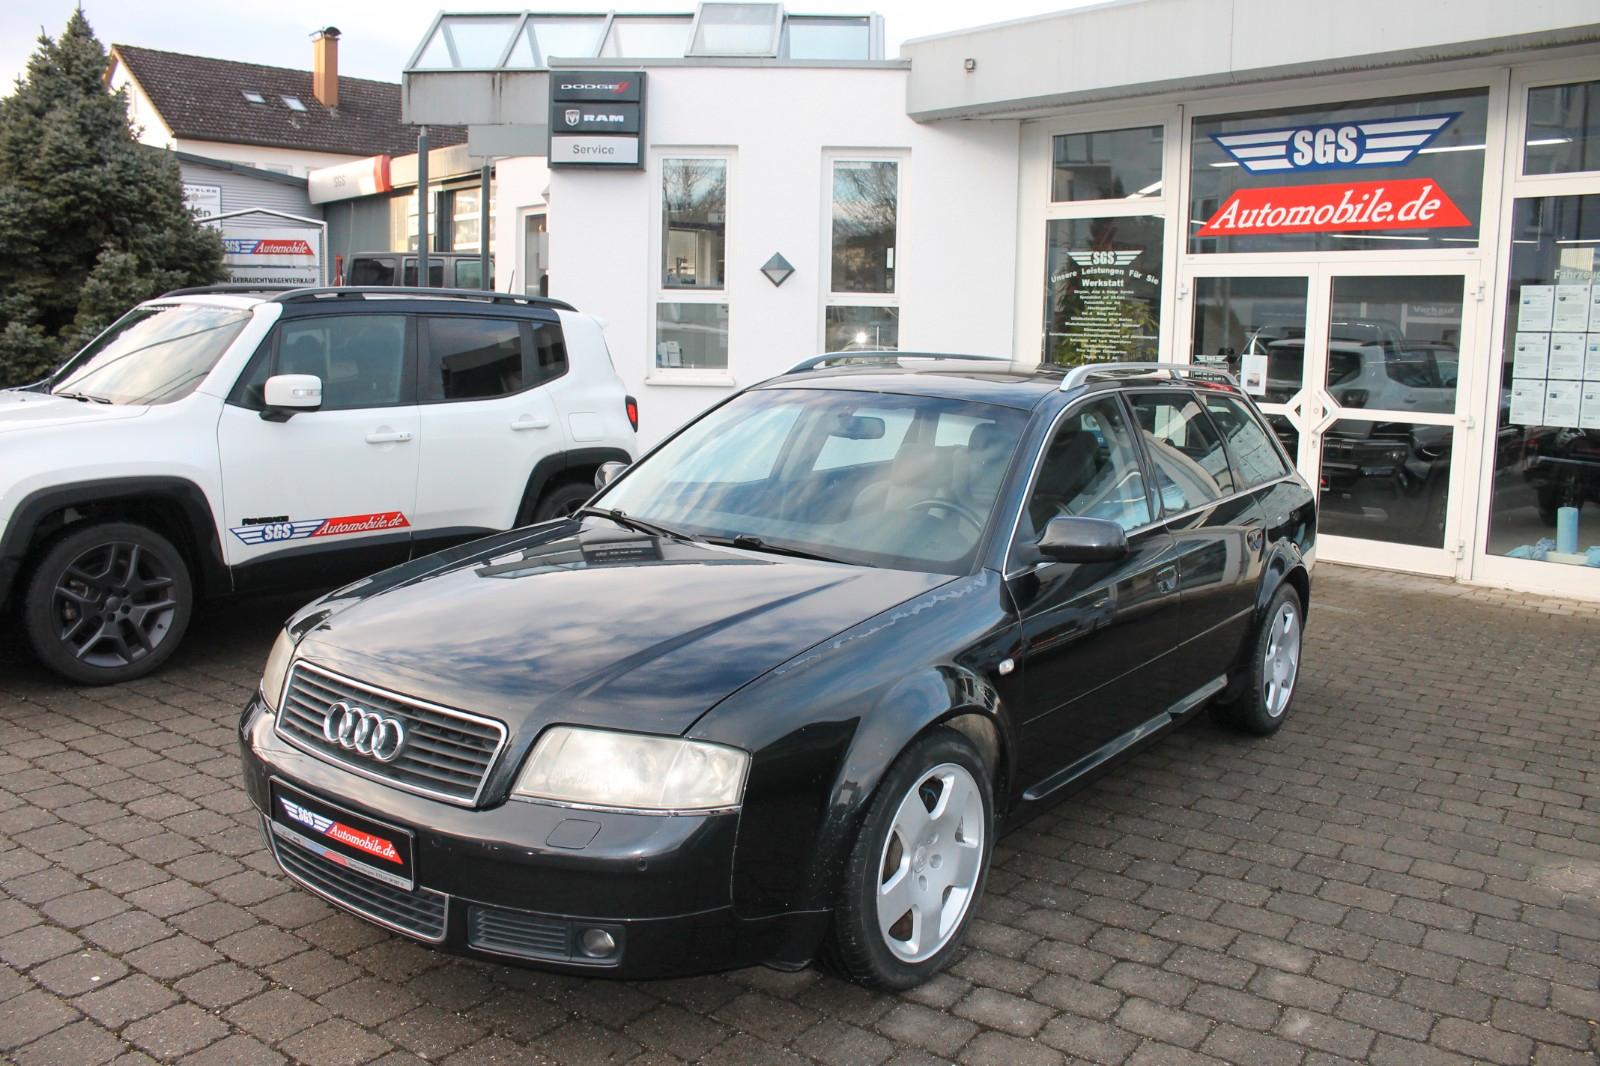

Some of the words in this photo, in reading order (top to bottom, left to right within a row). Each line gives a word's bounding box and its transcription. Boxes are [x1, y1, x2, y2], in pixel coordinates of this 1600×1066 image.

[583, 114, 624, 122] RAM
[572, 144, 615, 155] Service
[1293, 126, 1358, 166] SGS
[1210, 184, 1441, 230] Automobile.de
[224, 241, 240, 252] SGS
[256, 241, 308, 254] Automobile
[1093, 251, 1115, 265] SGS
[232, 277, 316, 285] GEBRAUCHTWAGENVERKAUF
[1051, 270, 1078, 283] Unsere
[1081, 267, 1124, 276] Leistungen
[1128, 269, 1142, 279] Für
[1146, 274, 1159, 285] Sie
[1081, 278, 1124, 287] Werkstatt
[264, 524, 291, 541] SGS
[316, 513, 403, 535] Automobile.de
[298, 807, 314, 826] SGS
[330, 824, 396, 858] Automobile.de
